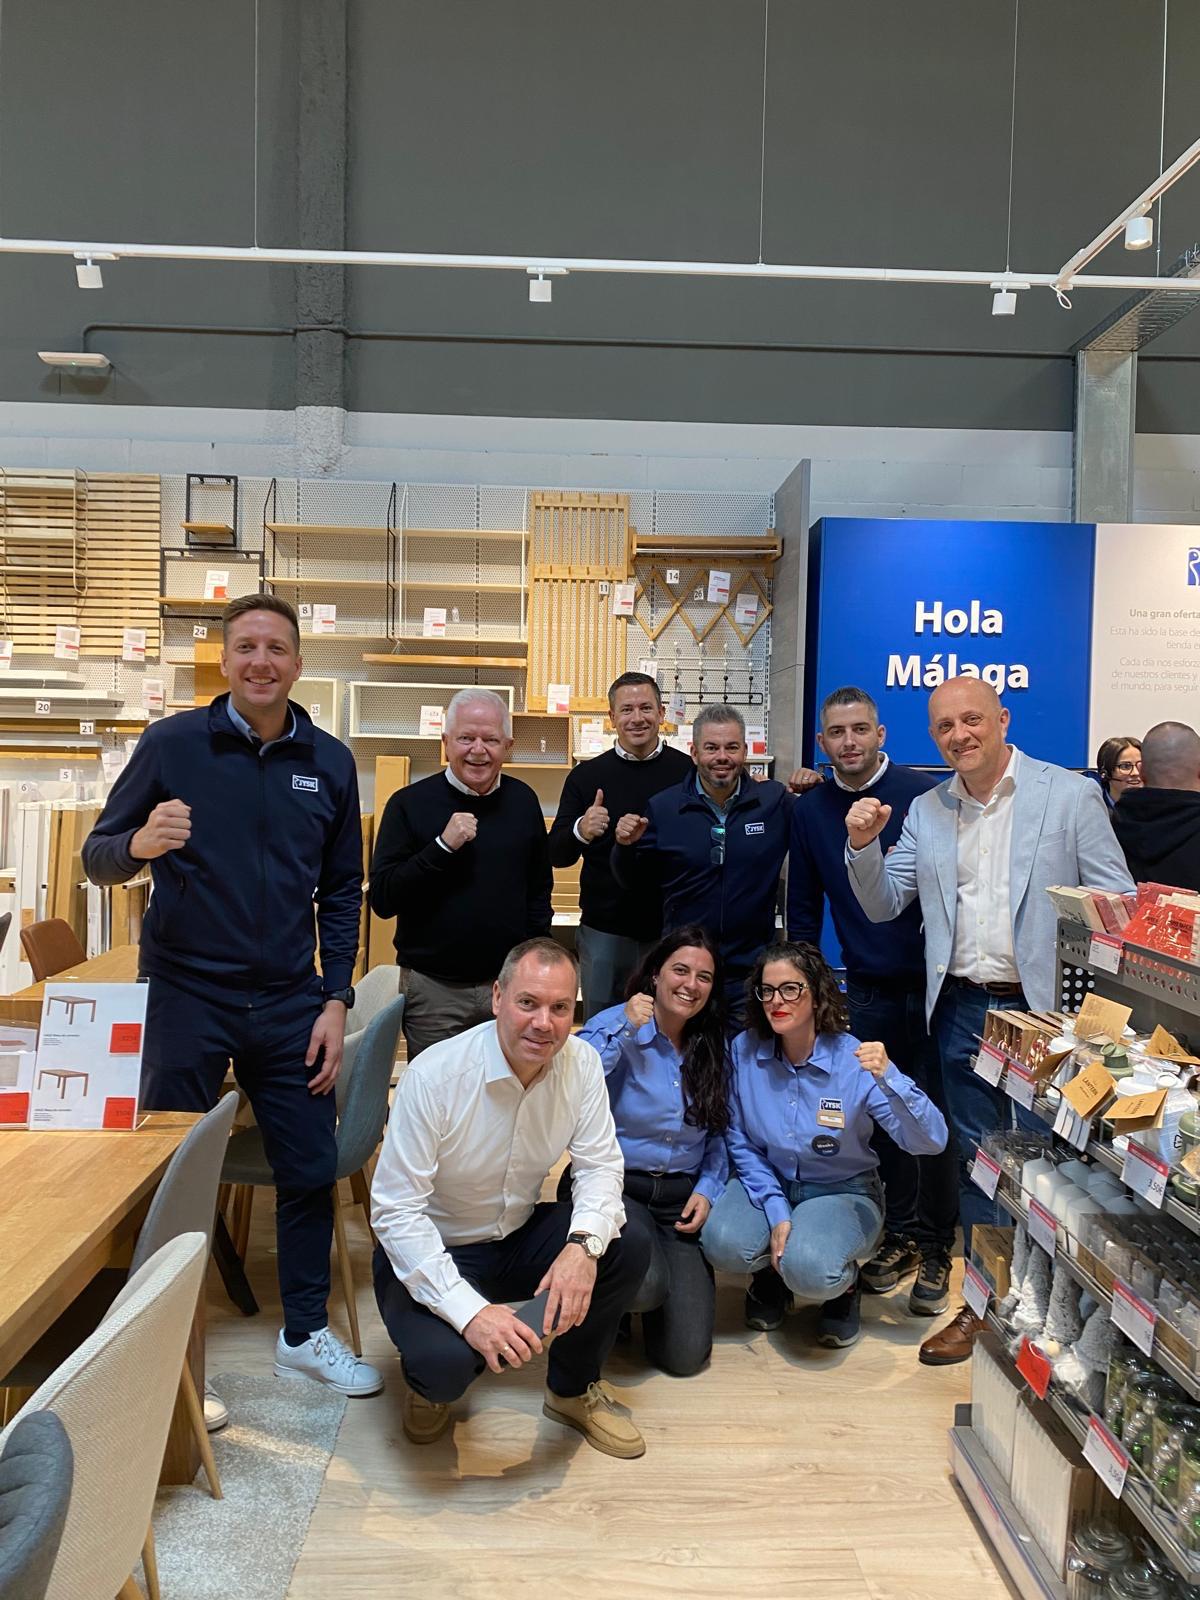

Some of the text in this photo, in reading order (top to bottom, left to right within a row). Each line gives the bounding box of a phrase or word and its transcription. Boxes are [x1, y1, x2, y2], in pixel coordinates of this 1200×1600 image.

[669, 572, 679, 580] 14
[600, 584, 608, 592] 11
[302, 606, 308, 614] 8
[1129, 608, 1148, 618] Una
[1150, 610, 1171, 620] gran
[914, 599, 1003, 634] Hola
[194, 627, 205, 636] 24
[886, 653, 1029, 696] Málaga
[37, 703, 49, 712] 20
[311, 706, 319, 714] 25
[81, 725, 92, 733] 21
[751, 766, 762, 775] 27
[63, 771, 69, 779] 5
[21, 784, 27, 792] 6
